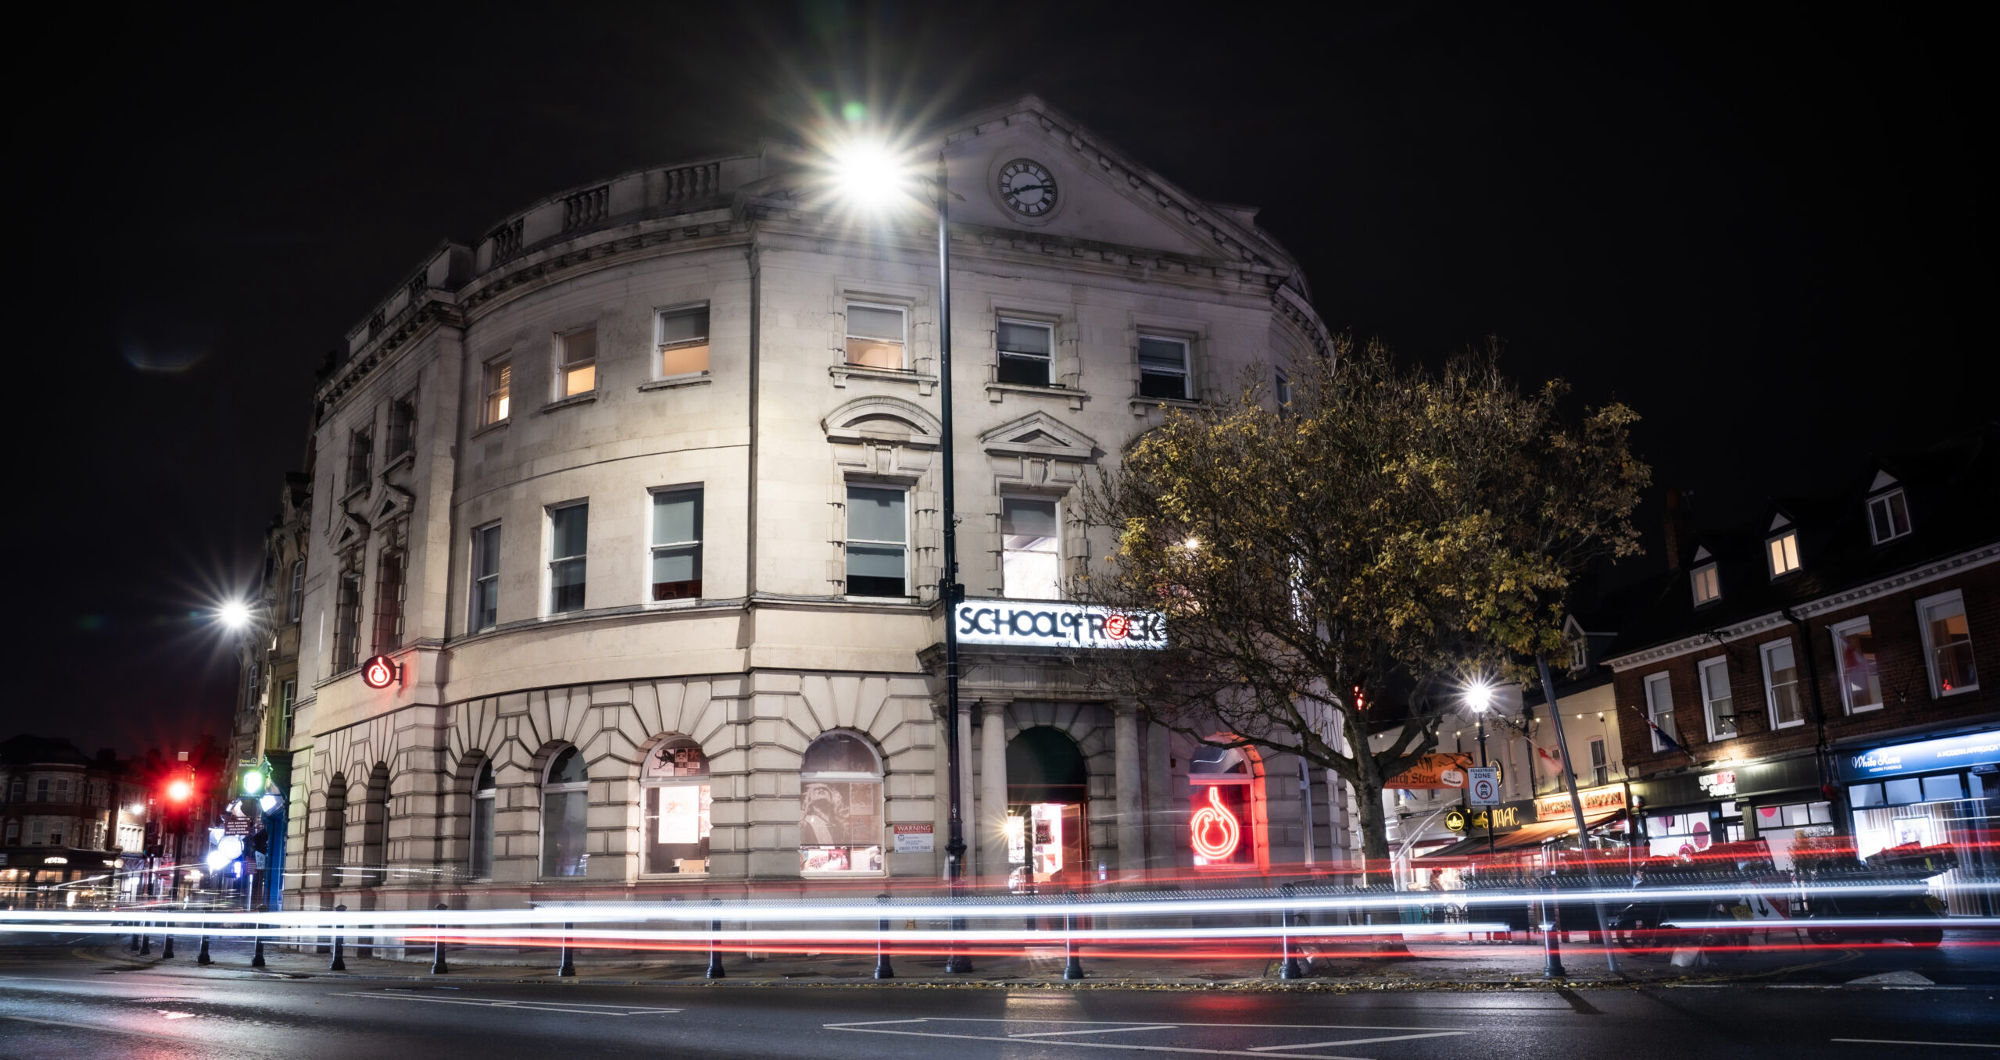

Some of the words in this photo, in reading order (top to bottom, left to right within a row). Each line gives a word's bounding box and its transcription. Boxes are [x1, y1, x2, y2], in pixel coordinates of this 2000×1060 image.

[959, 607, 1067, 638] SCHOOL
[1087, 612, 1164, 641] ROCK
[1851, 755, 1877, 769] White
[1411, 772, 1437, 784] Street
